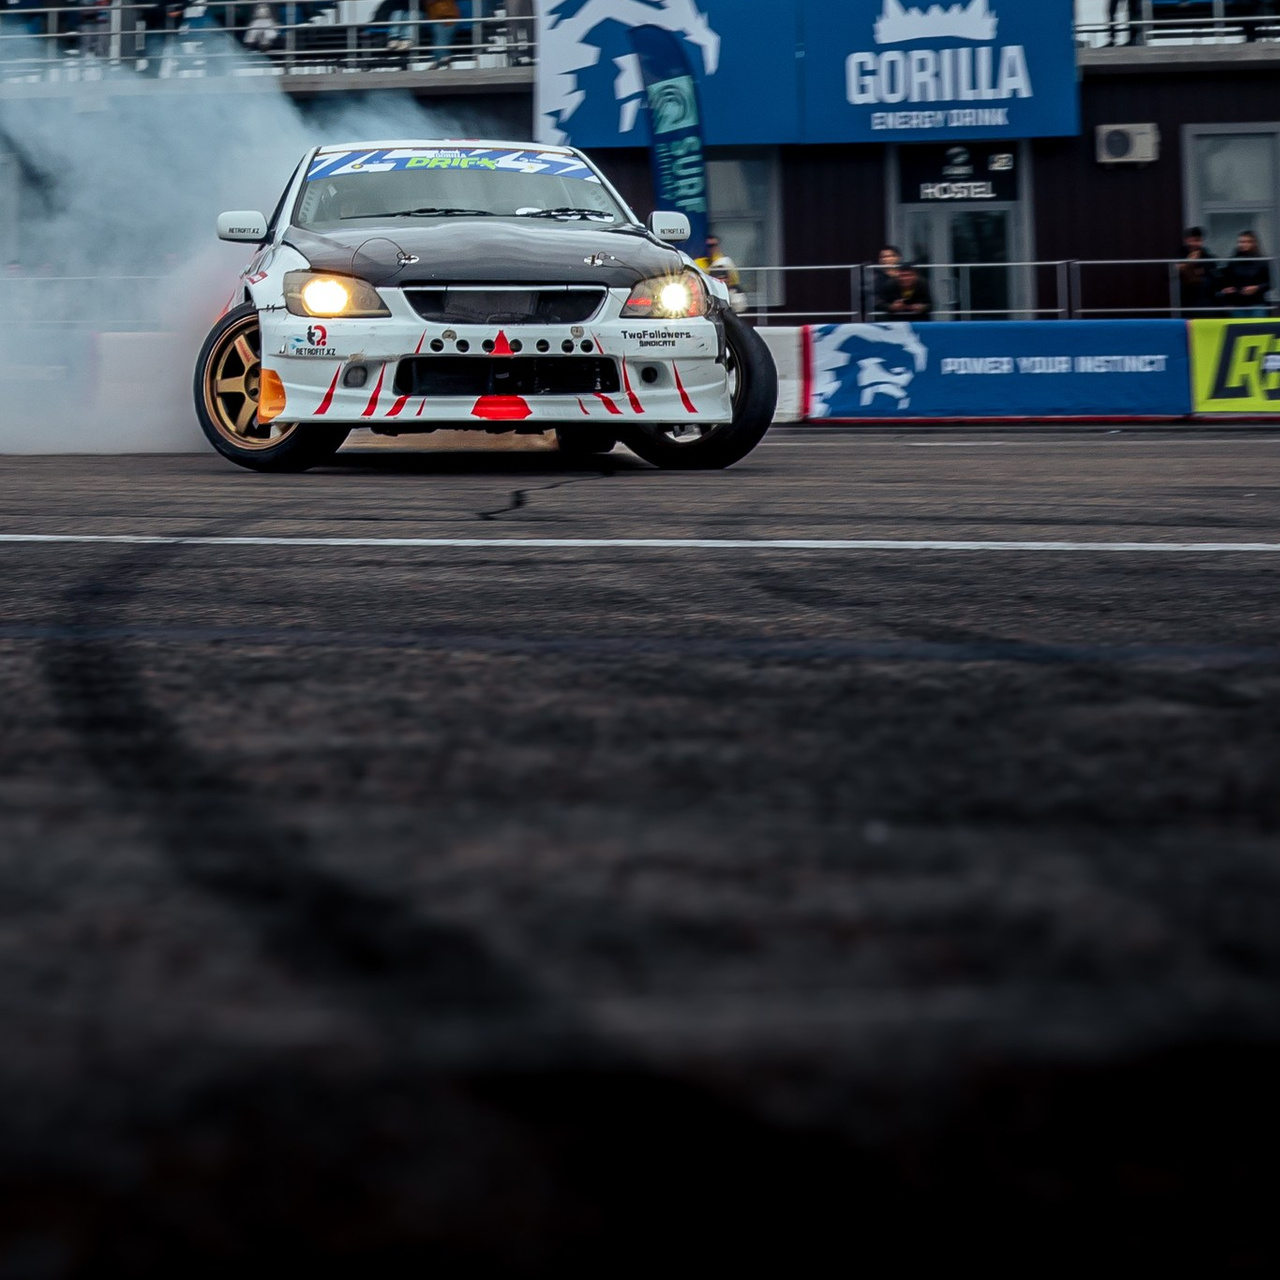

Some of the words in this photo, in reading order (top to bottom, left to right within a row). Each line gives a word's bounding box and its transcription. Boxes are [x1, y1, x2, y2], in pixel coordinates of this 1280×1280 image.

[845, 44, 1034, 105] GORILLA
[870, 110, 946, 130] ENERGY
[947, 108, 1009, 128] DRINK
[405, 156, 496, 170] DRIFT
[671, 135, 707, 213] SURF
[920, 181, 997, 199] HOSTEL
[621, 330, 692, 339] TwoFollowers
[295, 347, 336, 356] RETROFIT.KZ
[941, 357, 1014, 374] POWER
[1016, 356, 1071, 373] YOUR
[1074, 355, 1168, 372] INSTINCT
